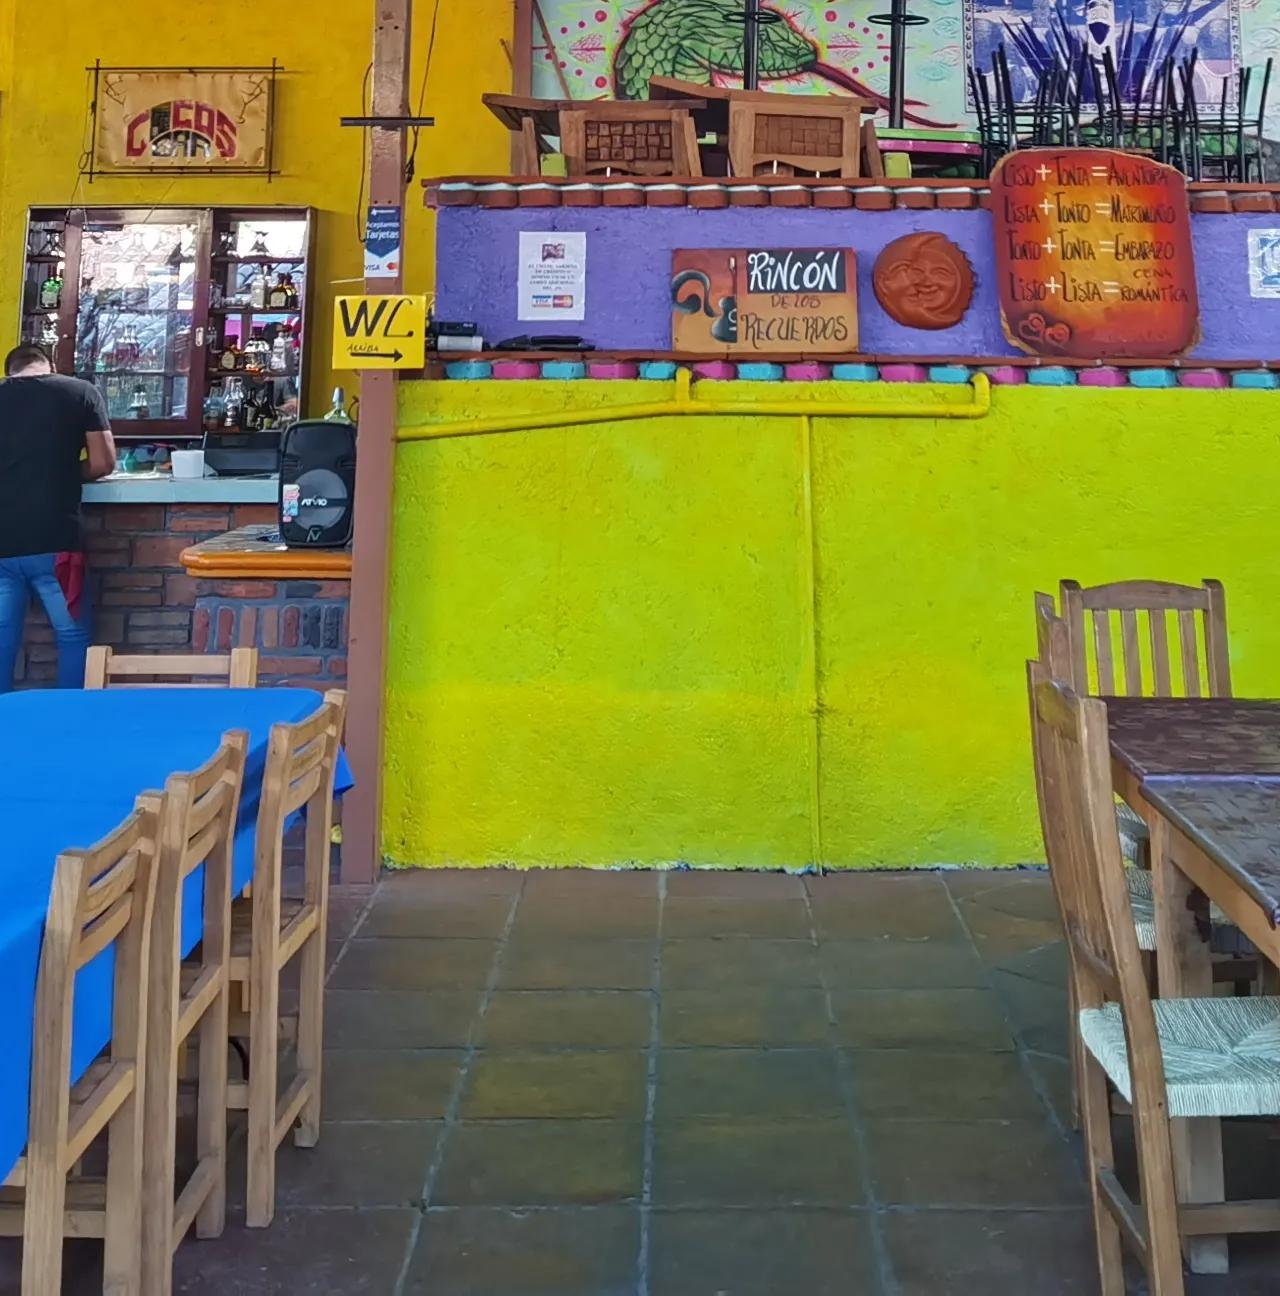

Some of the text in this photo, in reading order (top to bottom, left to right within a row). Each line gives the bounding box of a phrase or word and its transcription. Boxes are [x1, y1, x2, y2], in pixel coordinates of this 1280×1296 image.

[366, 230, 400, 240] Tarjetas
[770, 294, 791, 308] DE
[339, 297, 414, 338] WC
[740, 312, 848, 350] RECUERDOS
